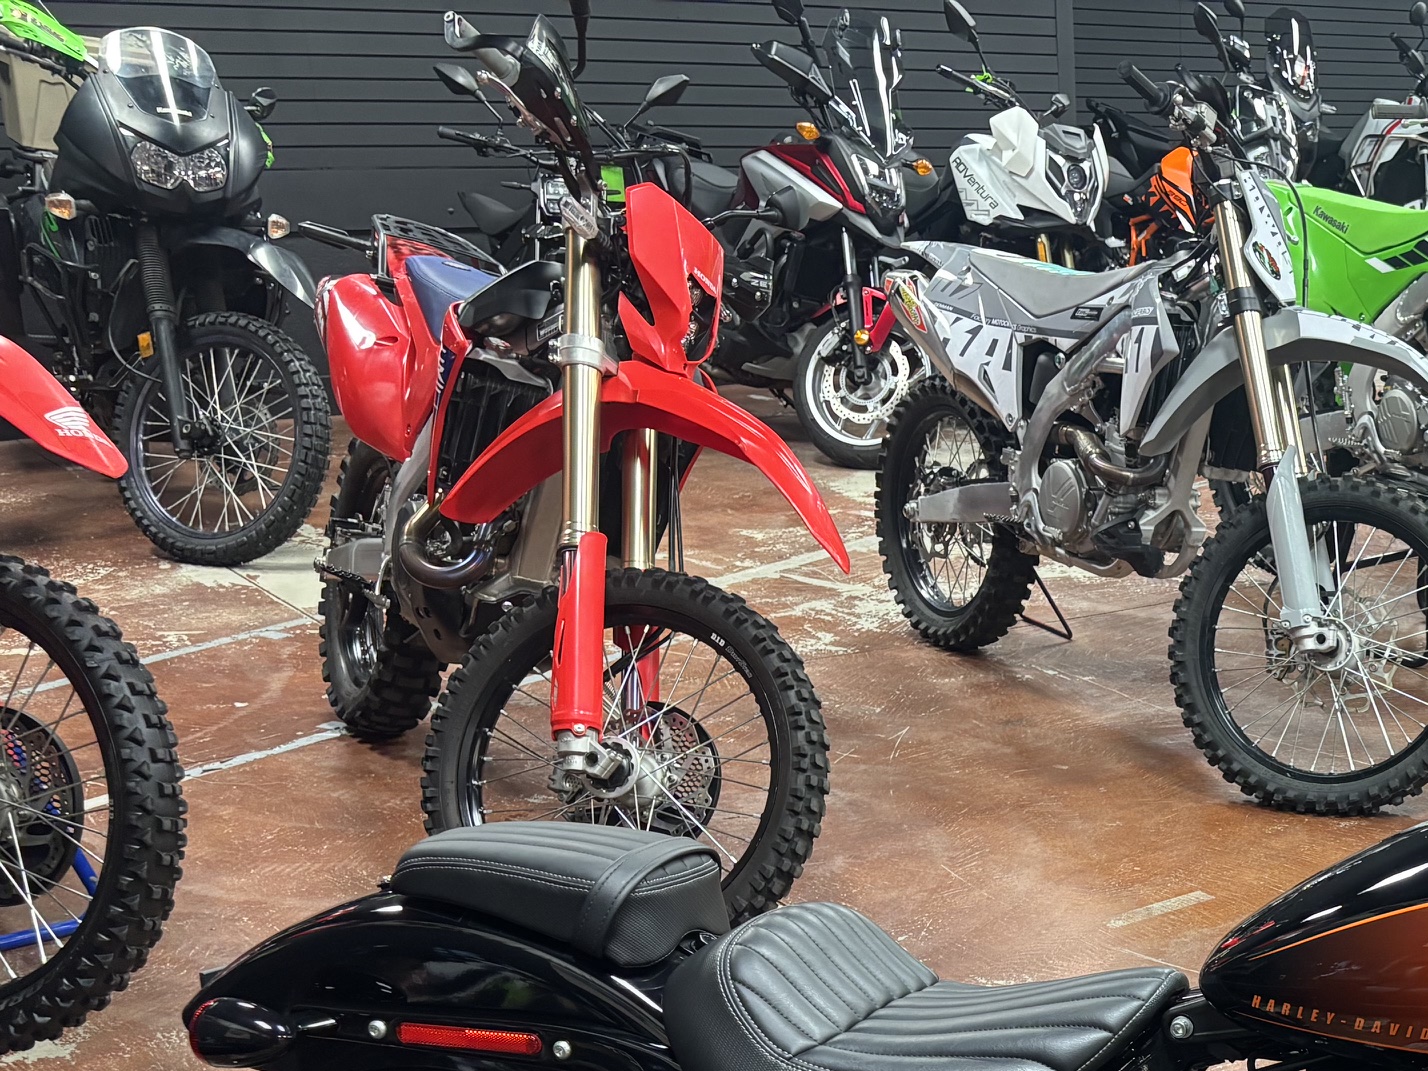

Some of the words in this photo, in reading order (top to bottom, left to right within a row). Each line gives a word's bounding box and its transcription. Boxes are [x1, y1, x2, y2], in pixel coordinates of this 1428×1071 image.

[1312, 206, 1350, 235] Kawasaki
[971, 313, 991, 326] Facry
[1017, 324, 1037, 334] Graphics
